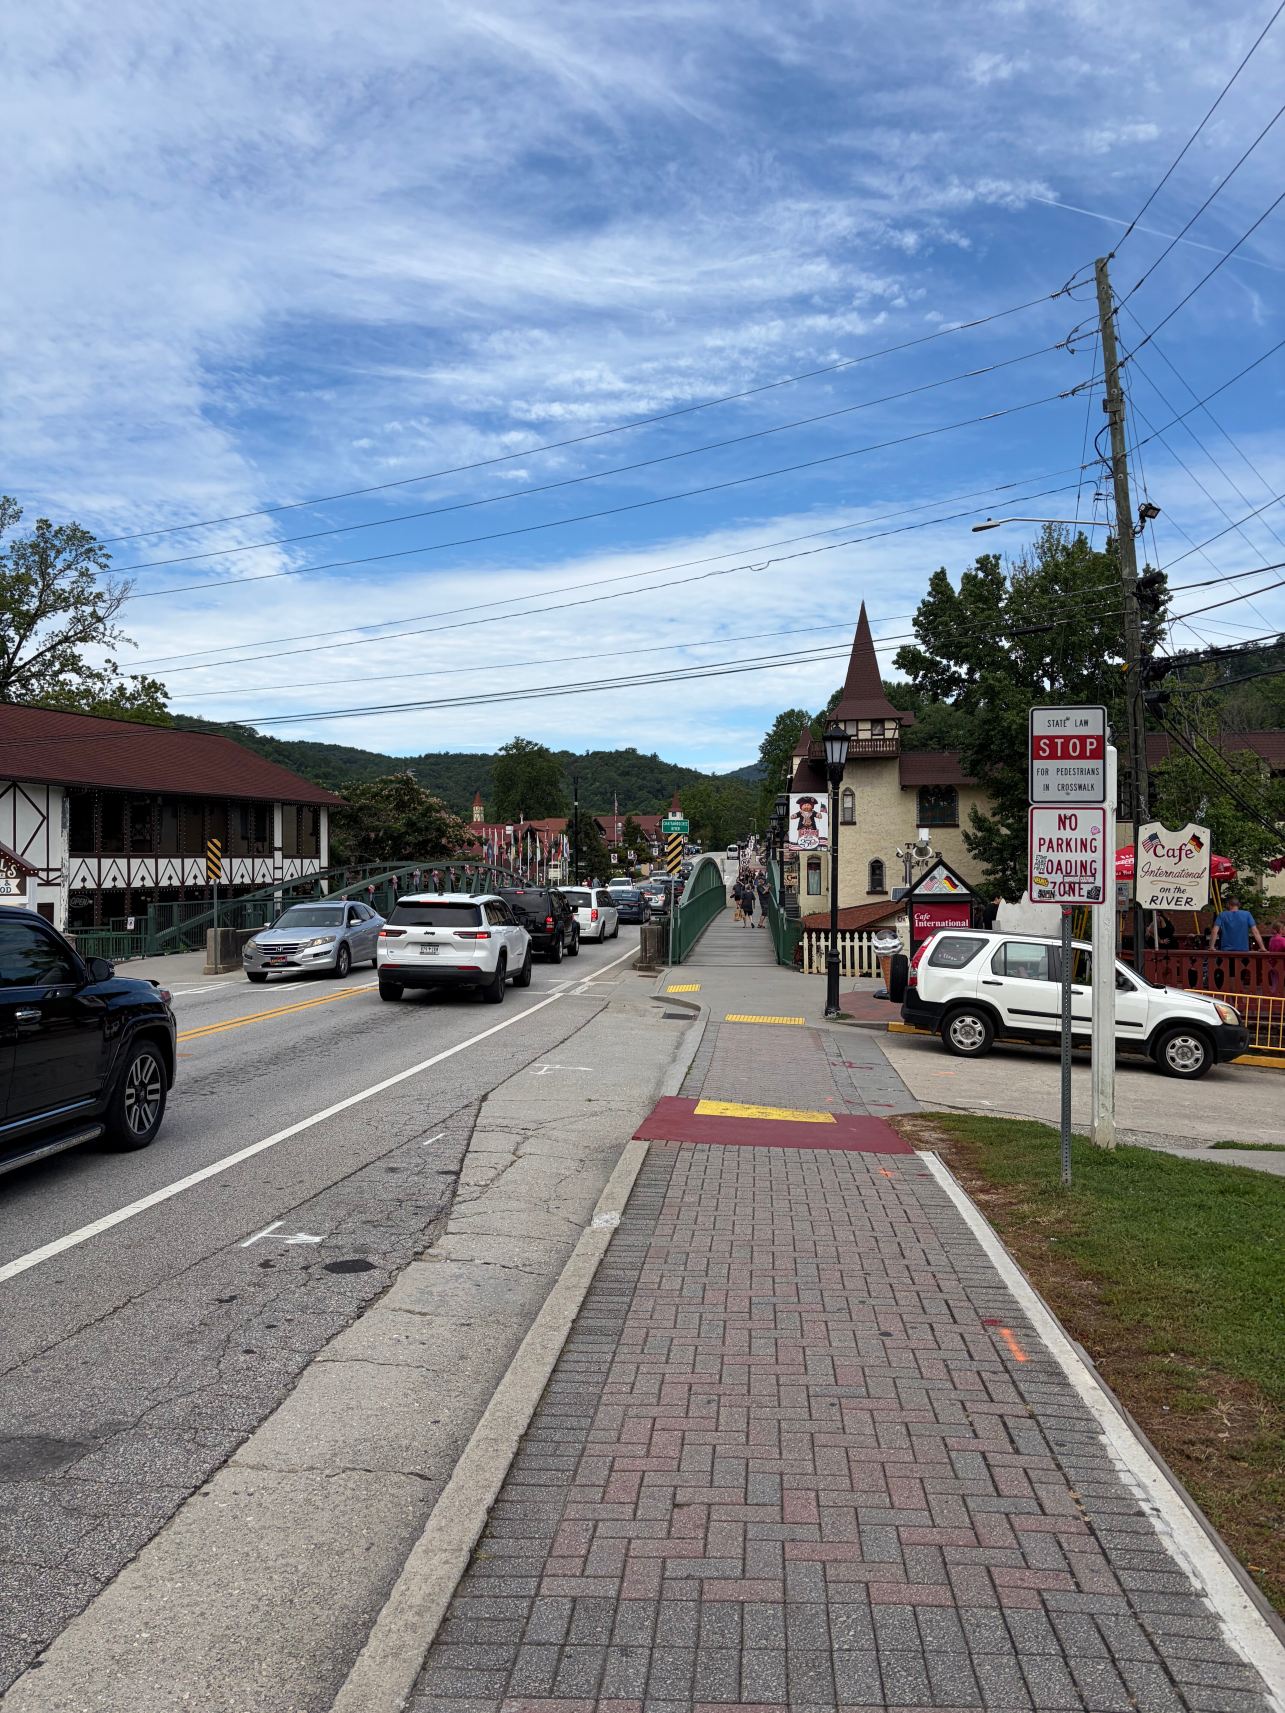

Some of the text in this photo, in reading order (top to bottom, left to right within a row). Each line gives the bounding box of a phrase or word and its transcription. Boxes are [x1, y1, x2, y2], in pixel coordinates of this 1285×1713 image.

[1047, 719, 1089, 728] STATE LAW
[1038, 738, 1097, 757] STOP
[1036, 767, 1100, 776] FOR PEDESTRIANS
[1043, 783, 1095, 792] IN CROSSWALK
[1057, 813, 1078, 831] NO
[1038, 837, 1097, 853] PARKING
[1153, 842, 1195, 865] Cafe
[1140, 861, 1207, 879] International
[1159, 886, 1187, 894] on the
[70, 897, 89, 906] OPEN
[1149, 895, 1194, 907] RIVER
[914, 912, 931, 920] Cafe
[915, 919, 969, 927] International
